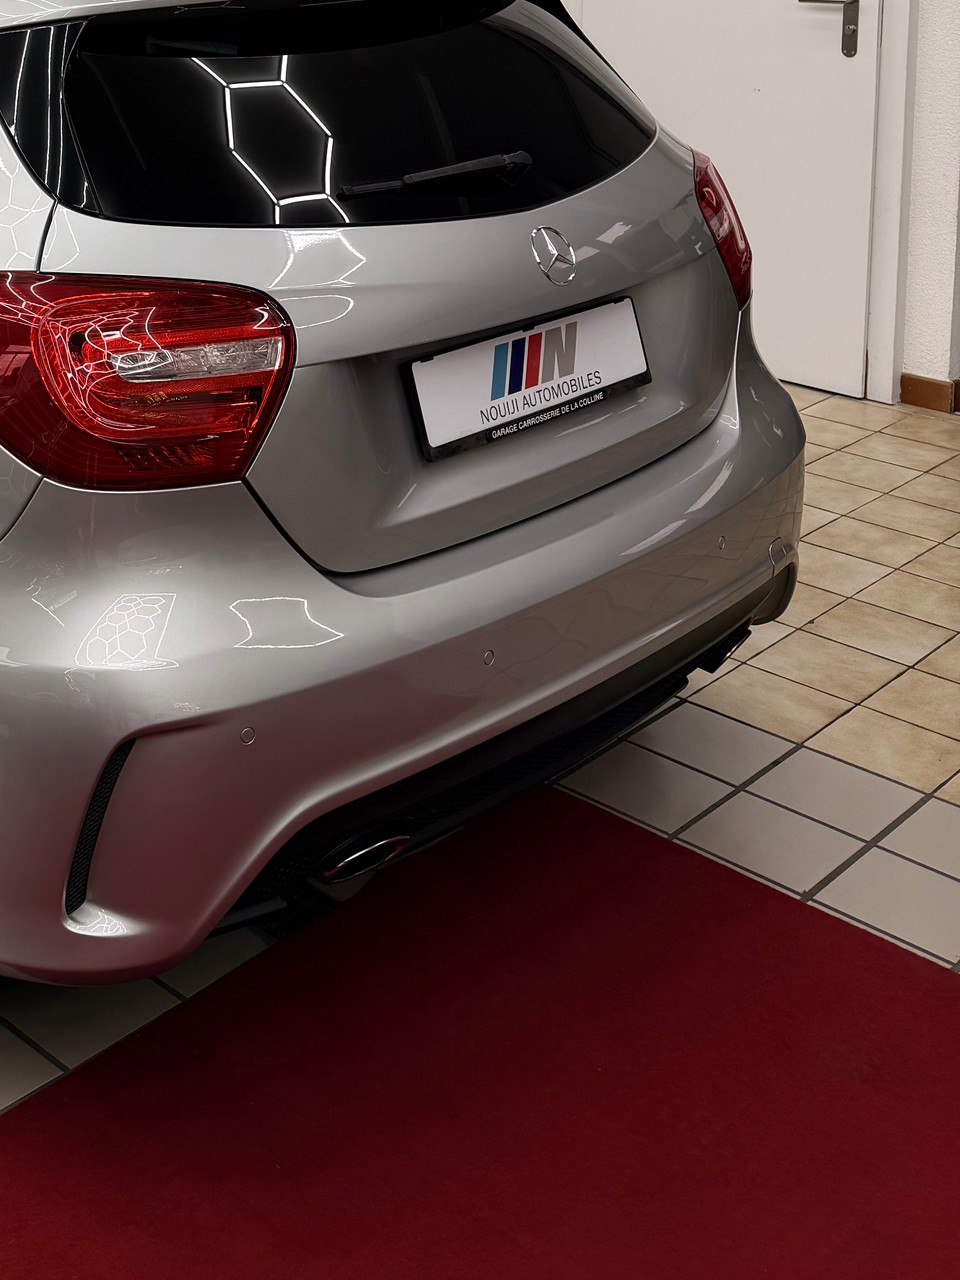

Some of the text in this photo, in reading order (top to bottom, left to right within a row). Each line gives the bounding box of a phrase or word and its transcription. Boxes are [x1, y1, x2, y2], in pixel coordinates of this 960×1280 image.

[480, 370, 602, 424] NOUIJI AUTOMOBILES
[491, 391, 604, 439] GARAGE CARROSSERIE DE LA COLLINE
